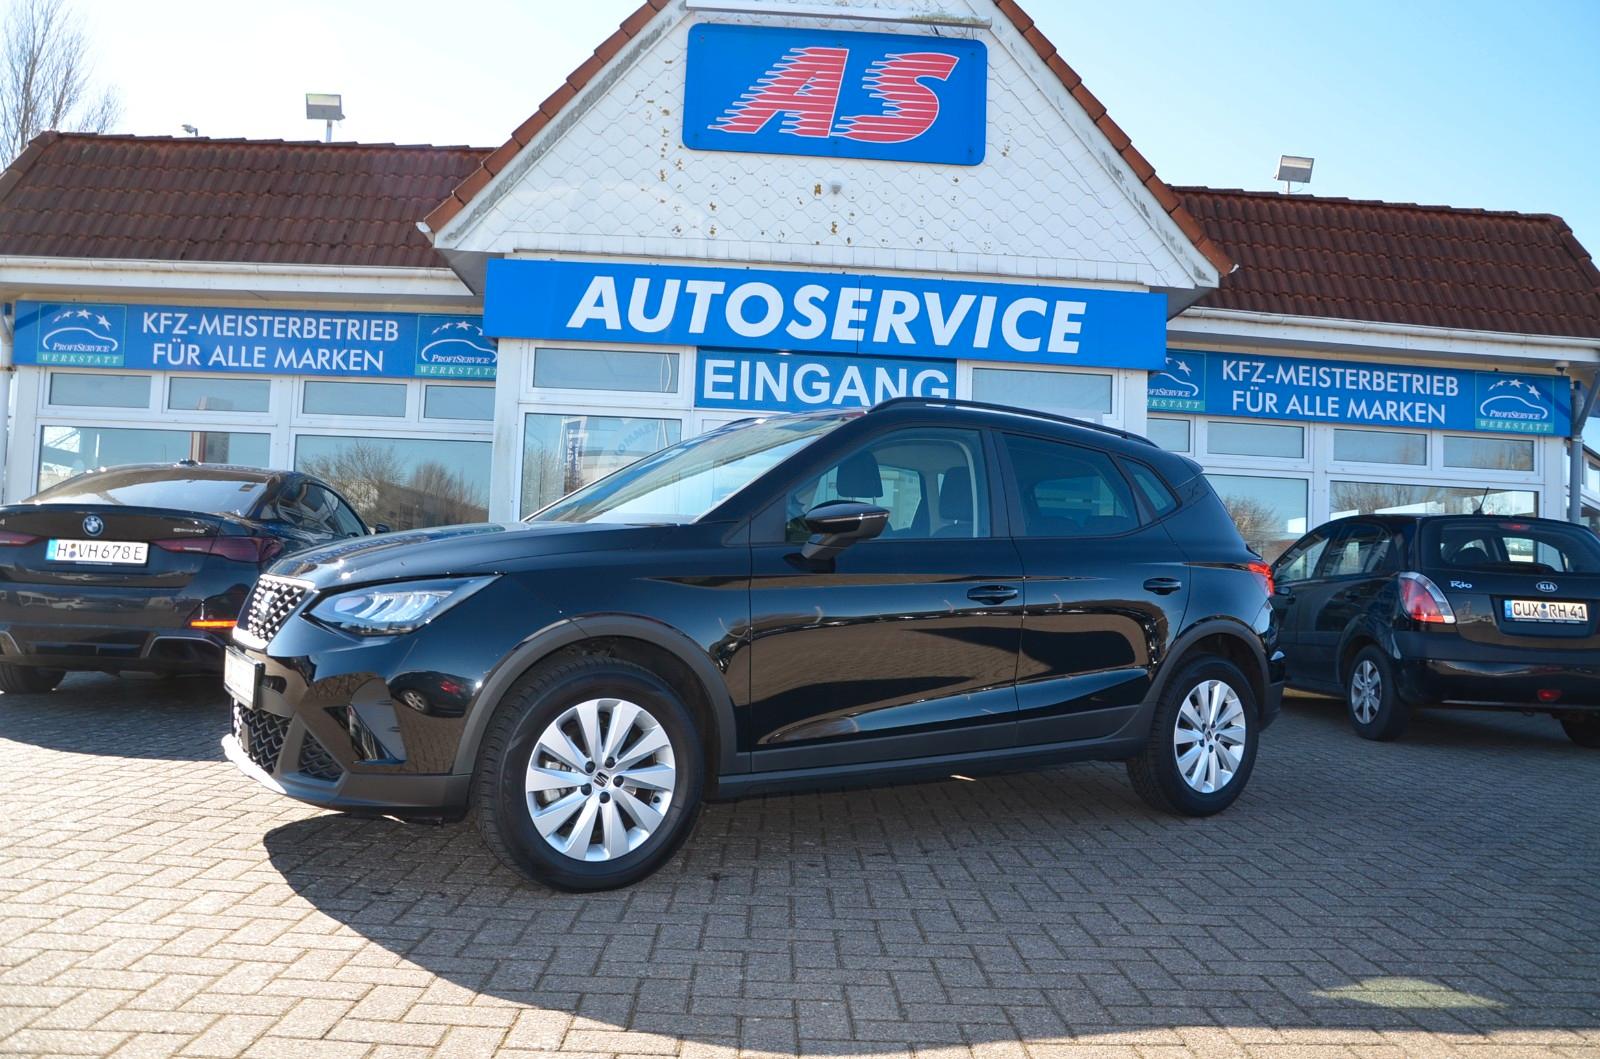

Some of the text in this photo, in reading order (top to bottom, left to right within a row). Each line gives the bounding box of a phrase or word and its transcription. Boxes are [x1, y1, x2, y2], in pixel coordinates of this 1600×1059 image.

[707, 47, 960, 143] AS
[143, 312, 399, 342] KFZ-MEISTERBETRIEB
[565, 275, 1087, 354] AUTOSERVICE
[42, 353, 119, 364] WERKSTATT
[153, 338, 384, 372] FÜR ALLE MARKEN
[703, 359, 950, 406] EINGANG
[1222, 360, 1459, 397] KFZ-MEISTERBETRIEB
[1232, 386, 1447, 425] FÜR ALLE MARKEN
[1480, 420, 1550, 432] WERKSTATT
[1450, 580, 1473, 590] Rio
[1539, 581, 1556, 592] KIA
[1513, 602, 1540, 617] CUX
